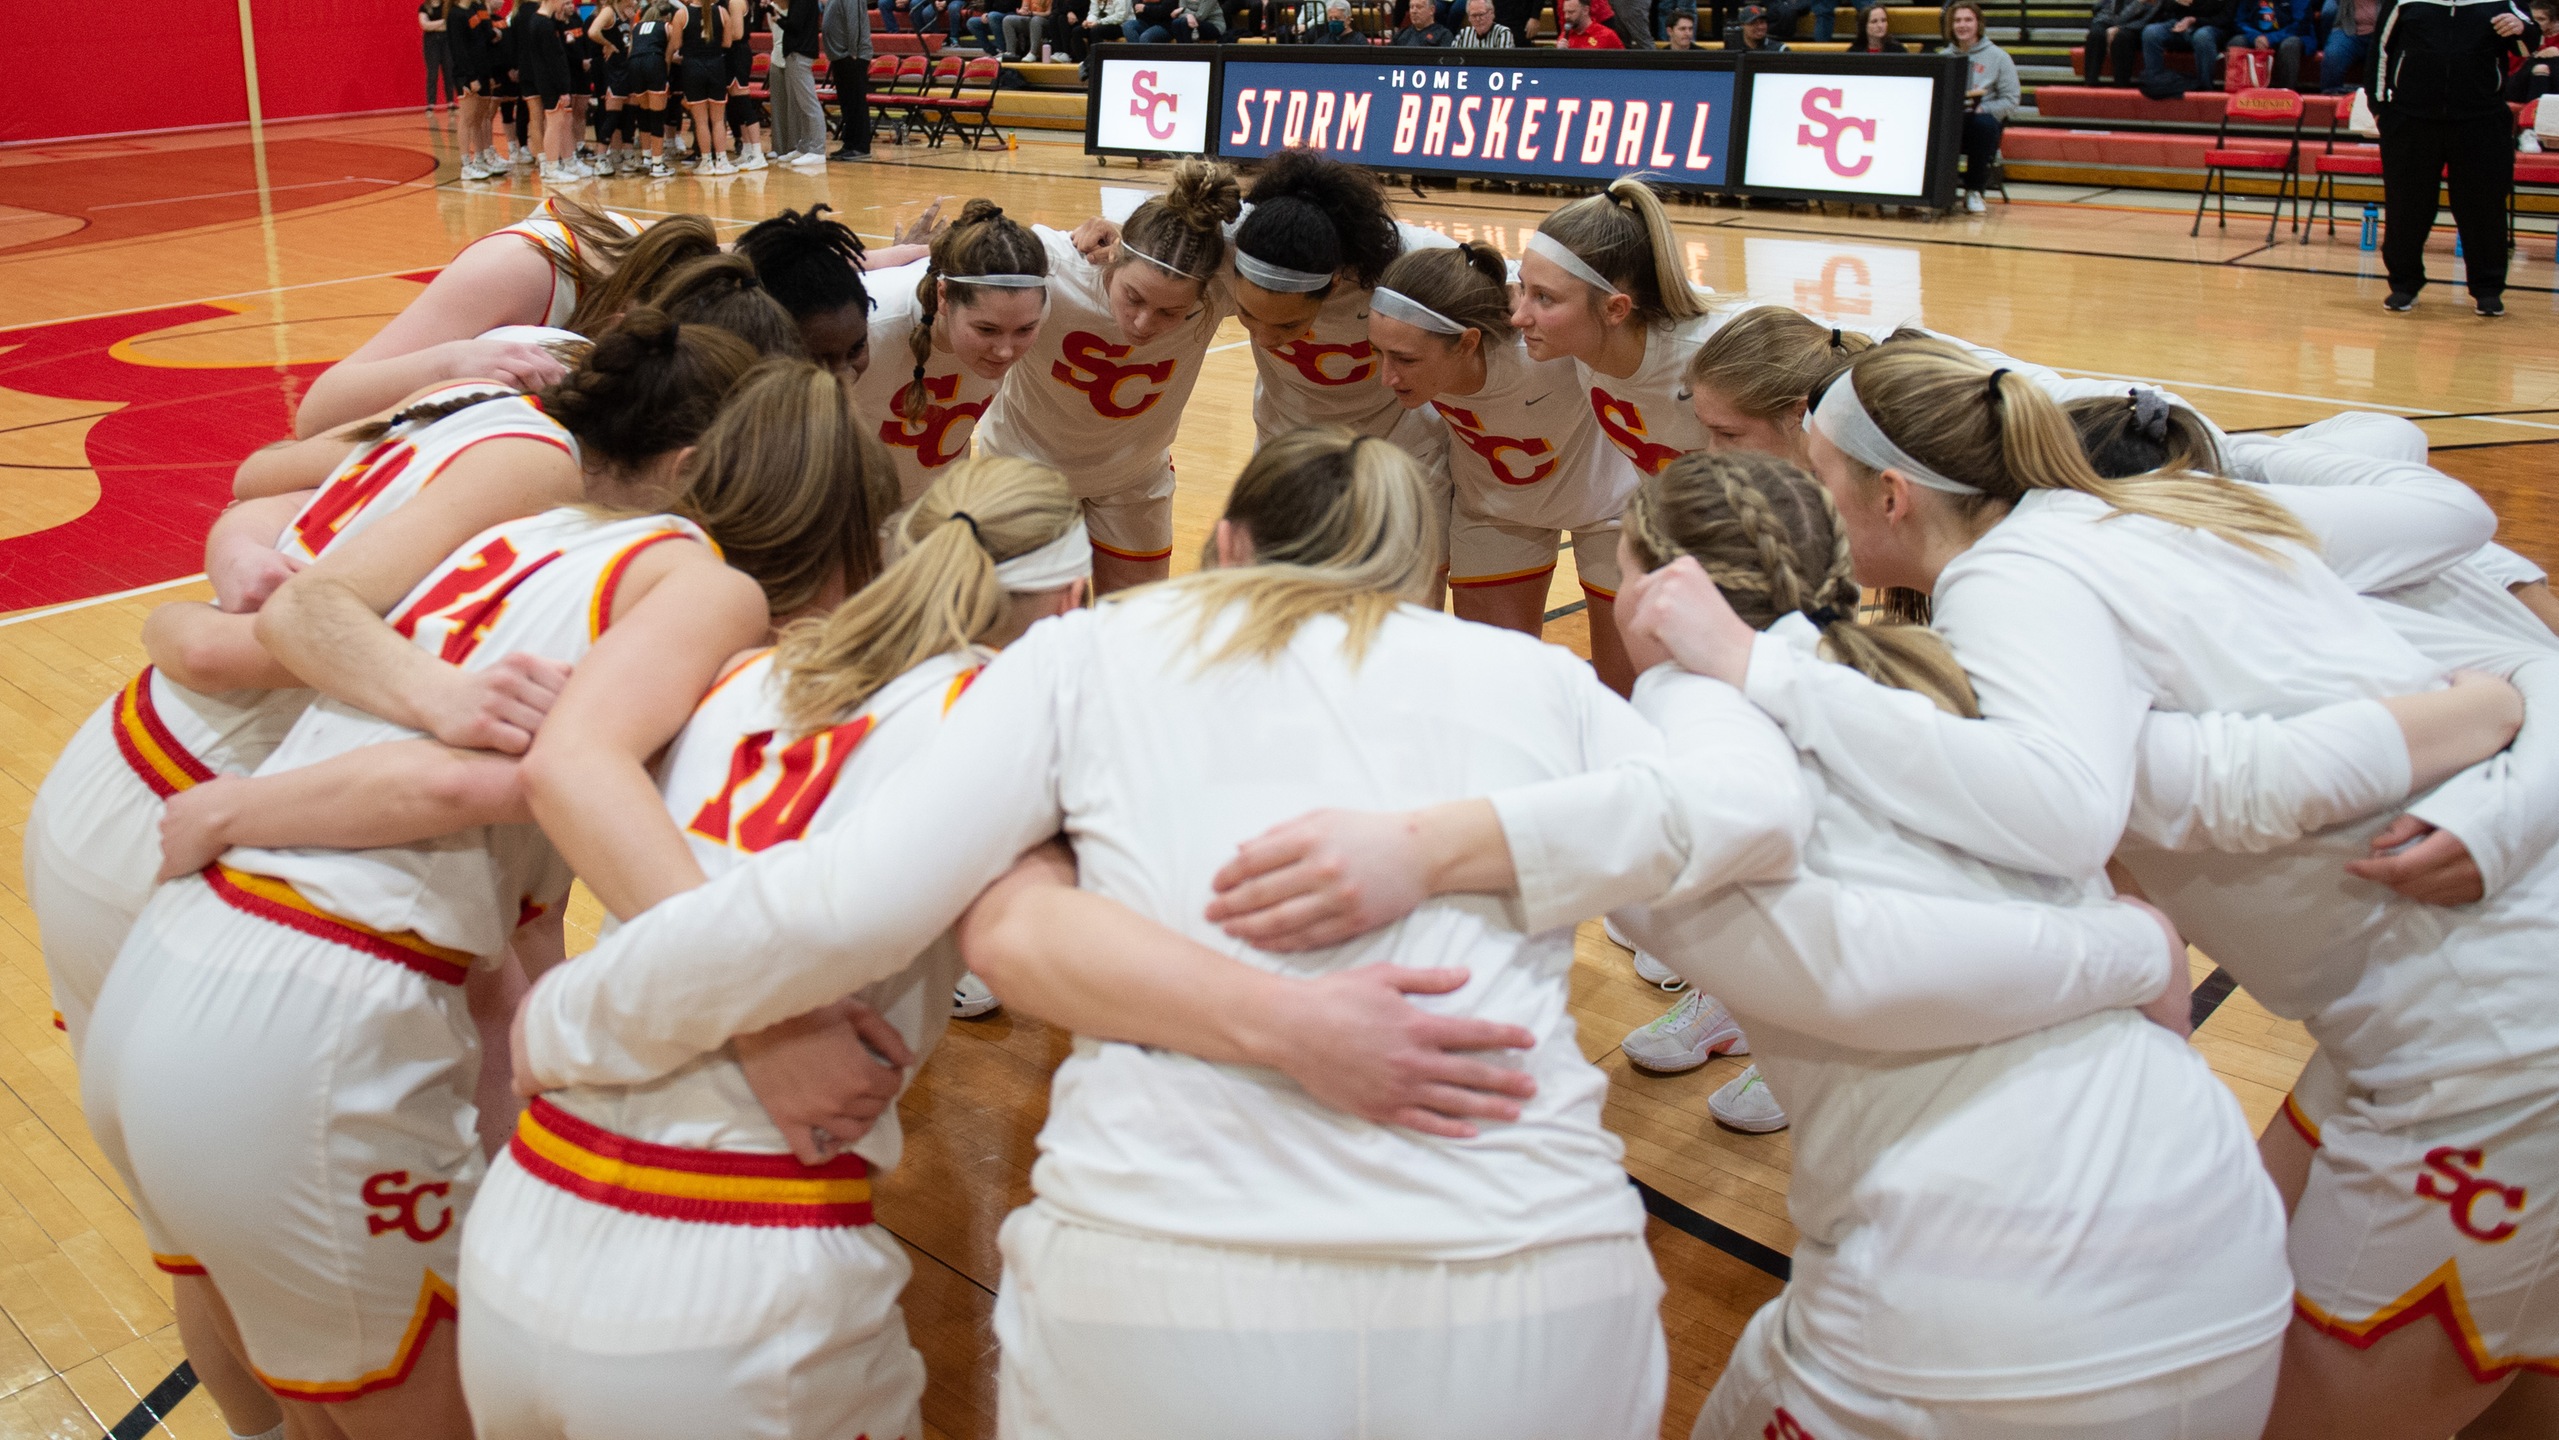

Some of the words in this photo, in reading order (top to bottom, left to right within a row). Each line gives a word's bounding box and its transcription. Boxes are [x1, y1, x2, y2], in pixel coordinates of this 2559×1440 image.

[638, 20, 657, 36] 10
[1130, 70, 1179, 140] SC
[1229, 87, 1374, 154] STORM
[1391, 92, 1714, 172] BASKETBALL
[1796, 86, 1877, 179] SC
[1051, 331, 1178, 419] SC
[880, 373, 994, 469] SC
[1430, 399, 1560, 486] SC
[390, 536, 566, 668] 24
[686, 714, 878, 856] 10
[361, 1170, 454, 1244] SC
[2414, 1146, 2527, 1244] SC
